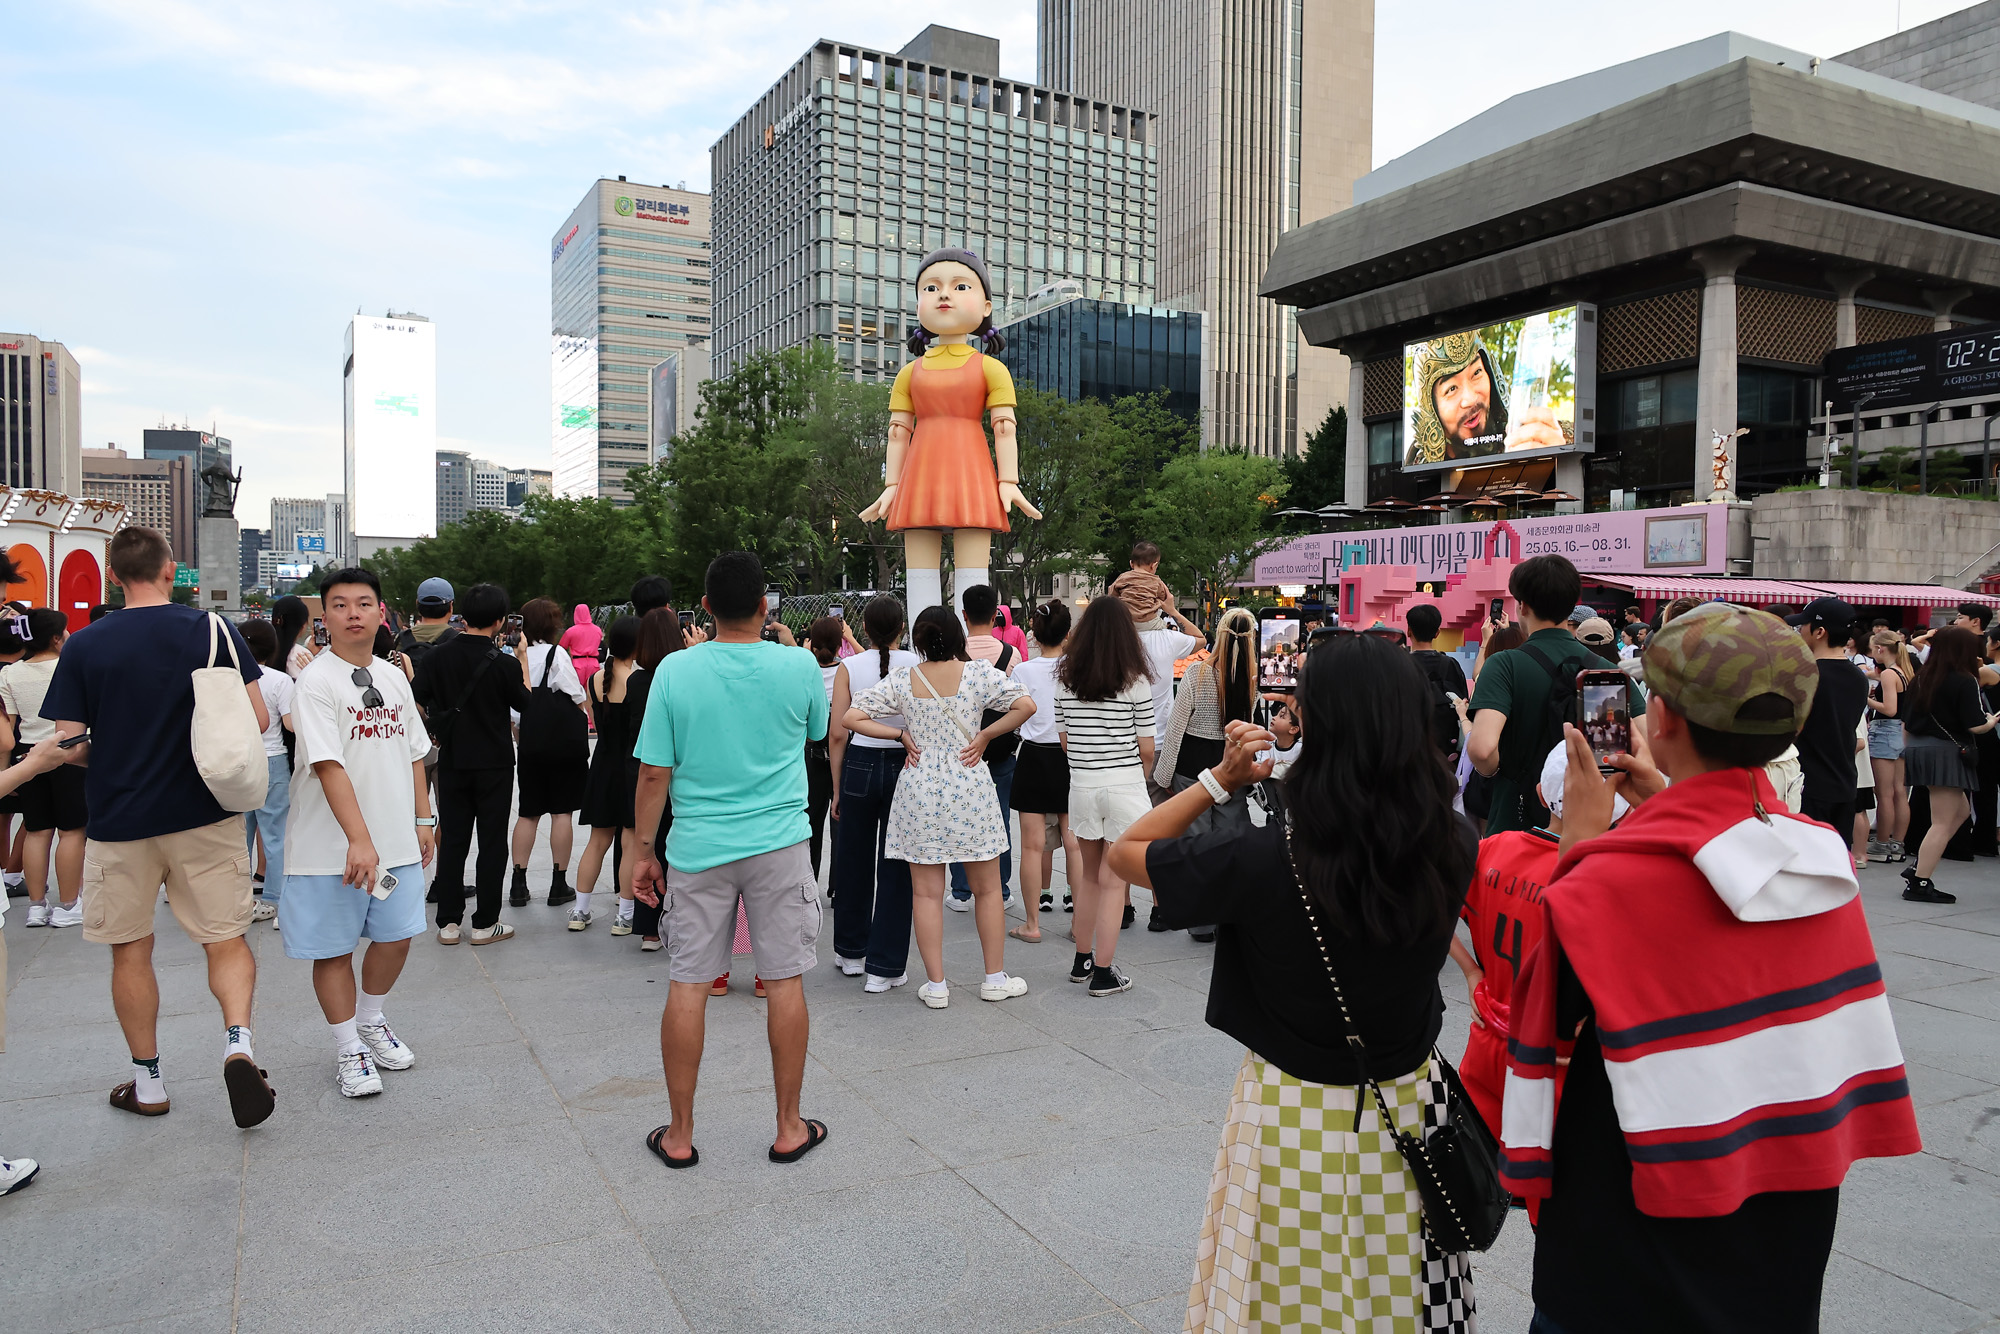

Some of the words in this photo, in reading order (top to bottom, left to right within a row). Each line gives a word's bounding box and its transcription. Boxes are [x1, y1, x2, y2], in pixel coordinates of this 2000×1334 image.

[635, 198, 690, 217] 감리회본부
[636, 211, 668, 223] Methodist
[669, 216, 690, 226] Center
[1943, 378, 1950, 386] A
[1951, 373, 1984, 385] GHOST
[1526, 524, 1573, 536] 세종문화회관
[1575, 522, 1601, 533] 미술관
[1261, 564, 1285, 575] monet
[1286, 564, 1294, 574] to
[1295, 561, 1320, 574] warhol
[1493, 912, 1524, 985] 4
